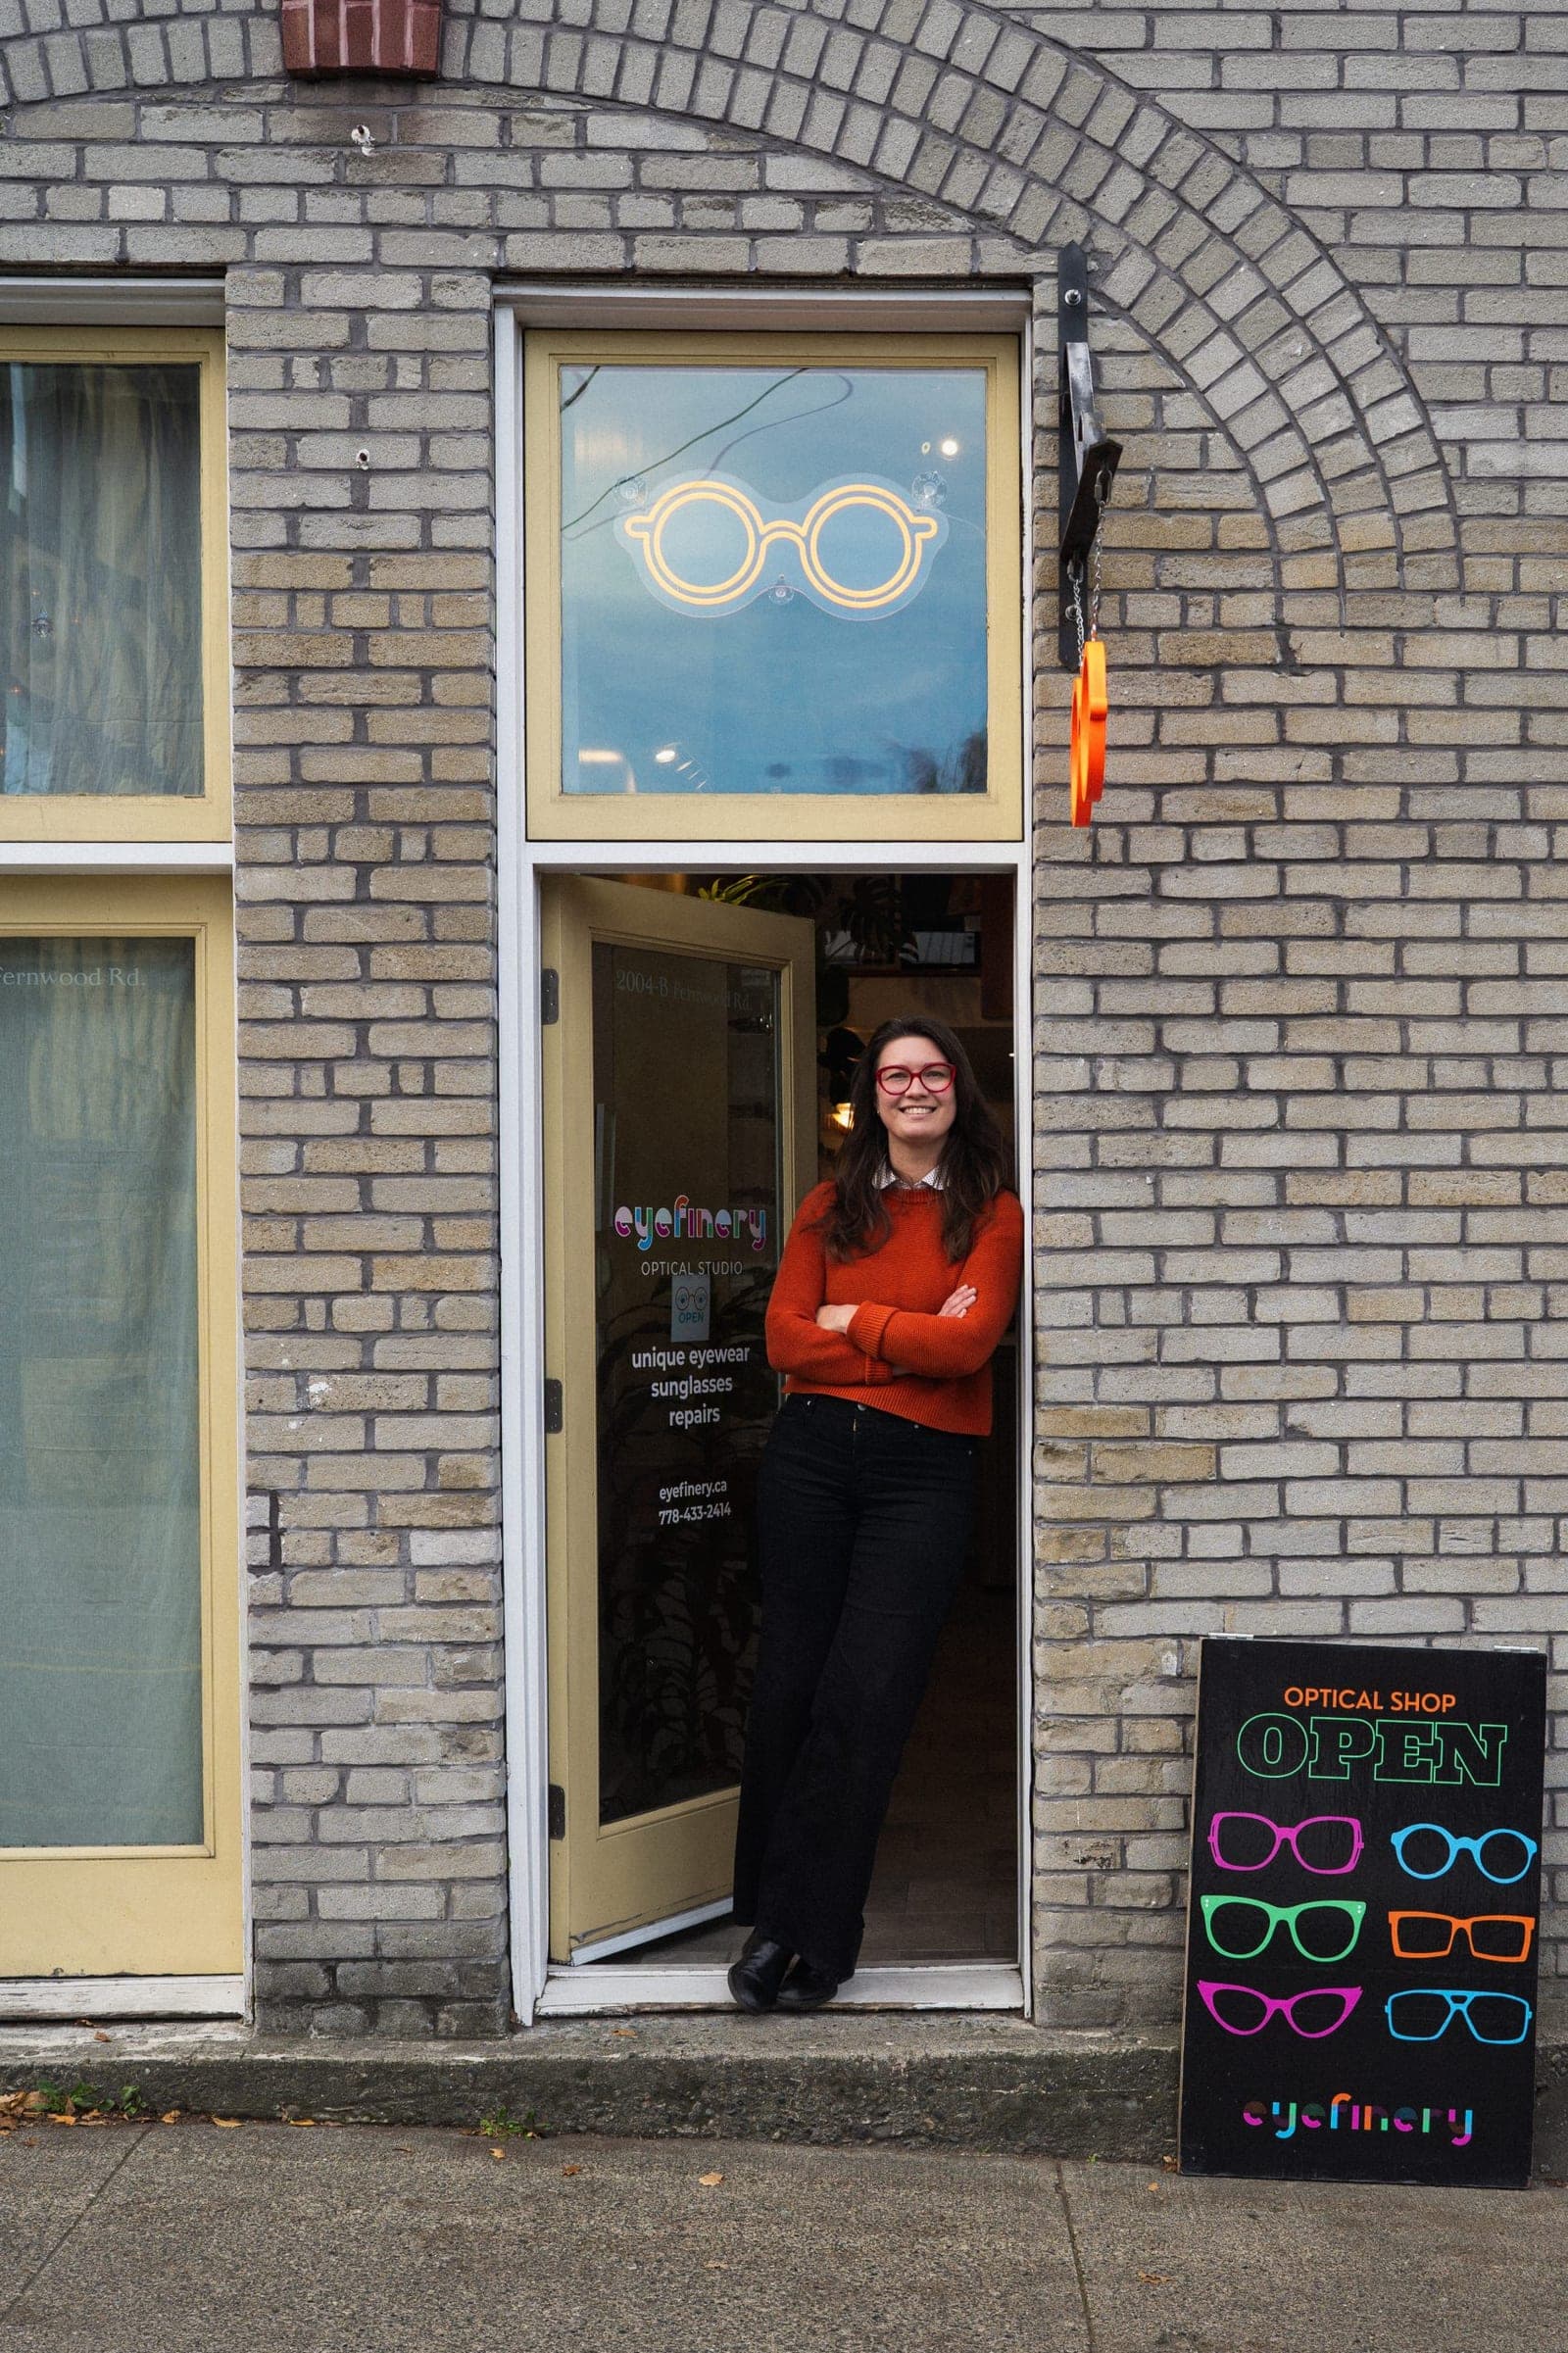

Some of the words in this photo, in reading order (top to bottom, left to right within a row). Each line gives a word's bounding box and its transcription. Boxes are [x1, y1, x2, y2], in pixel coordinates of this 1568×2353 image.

[0, 966, 101, 986] ernwood
[109, 967, 146, 986] Rd.
[614, 1195, 766, 1250] eyefinery
[641, 1261, 693, 1276] OPTICAL
[698, 1261, 743, 1276] STUDIO
[677, 1311, 706, 1324] OPEN
[632, 1346, 686, 1371] unique
[689, 1346, 751, 1369] eyewear
[651, 1375, 733, 1399] sunglasses
[669, 1403, 720, 1429] repairs
[659, 1480, 727, 1502] eyefinery.ca
[658, 1501, 731, 1525] 778-433-2414
[1284, 1687, 1384, 1711] OPTICAL
[1391, 1691, 1456, 1713] SHOP
[1237, 1712, 1508, 1787] OPEN
[1243, 2092, 1473, 2146] eyefinery
